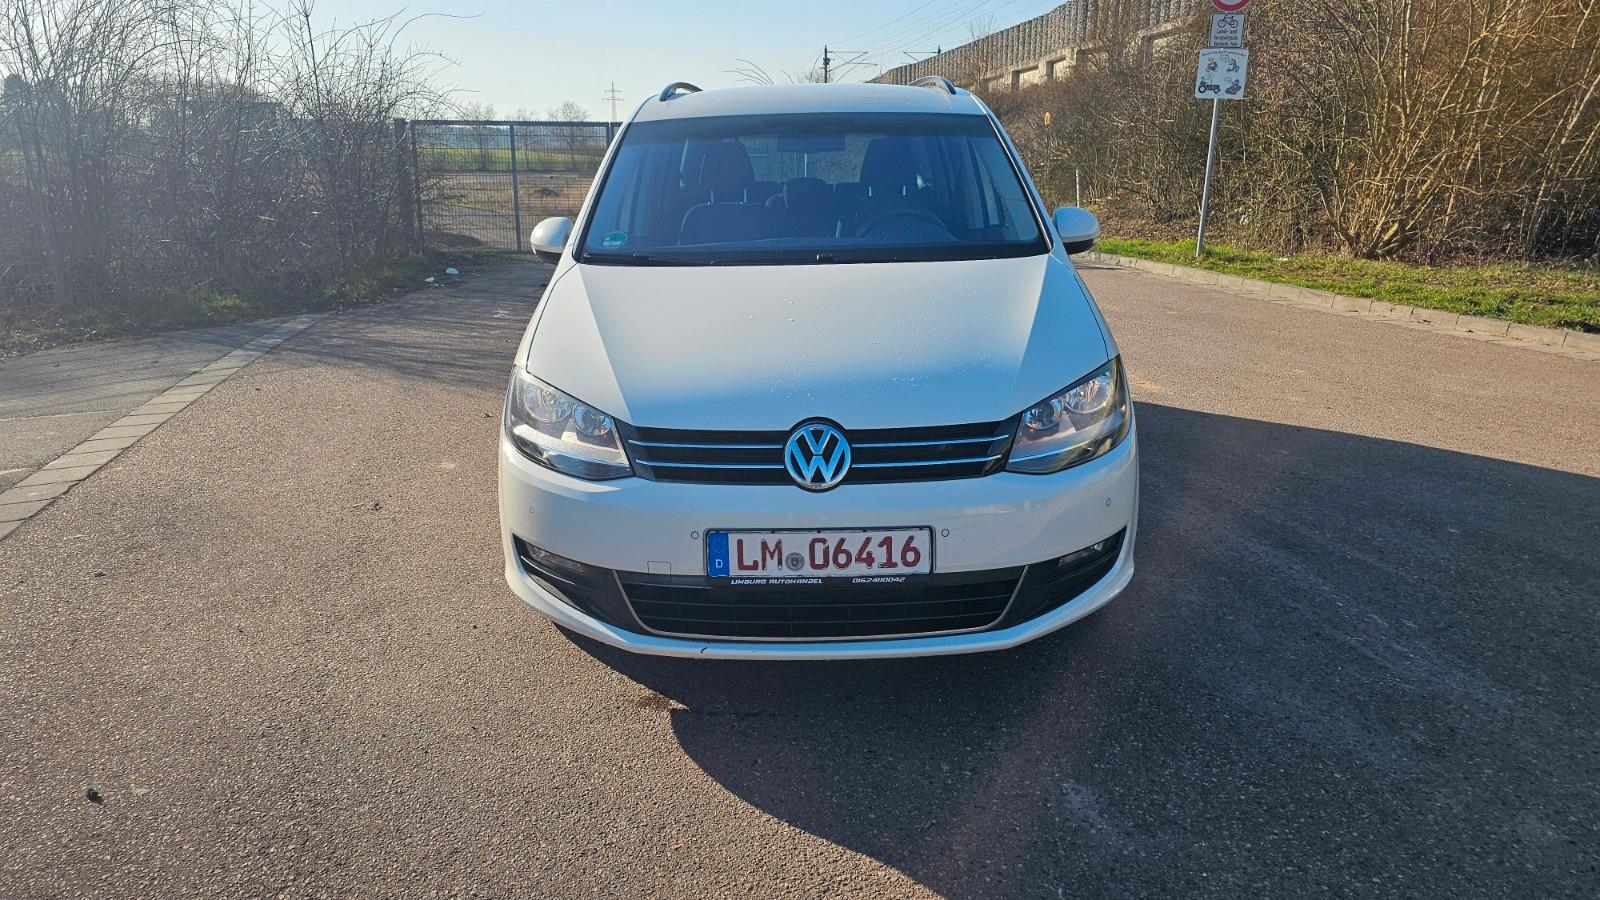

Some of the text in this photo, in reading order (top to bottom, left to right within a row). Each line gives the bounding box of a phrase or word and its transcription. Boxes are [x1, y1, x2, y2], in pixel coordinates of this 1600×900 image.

[788, 424, 847, 486] VW
[715, 560, 723, 569] D
[736, 535, 922, 571] LM 06416
